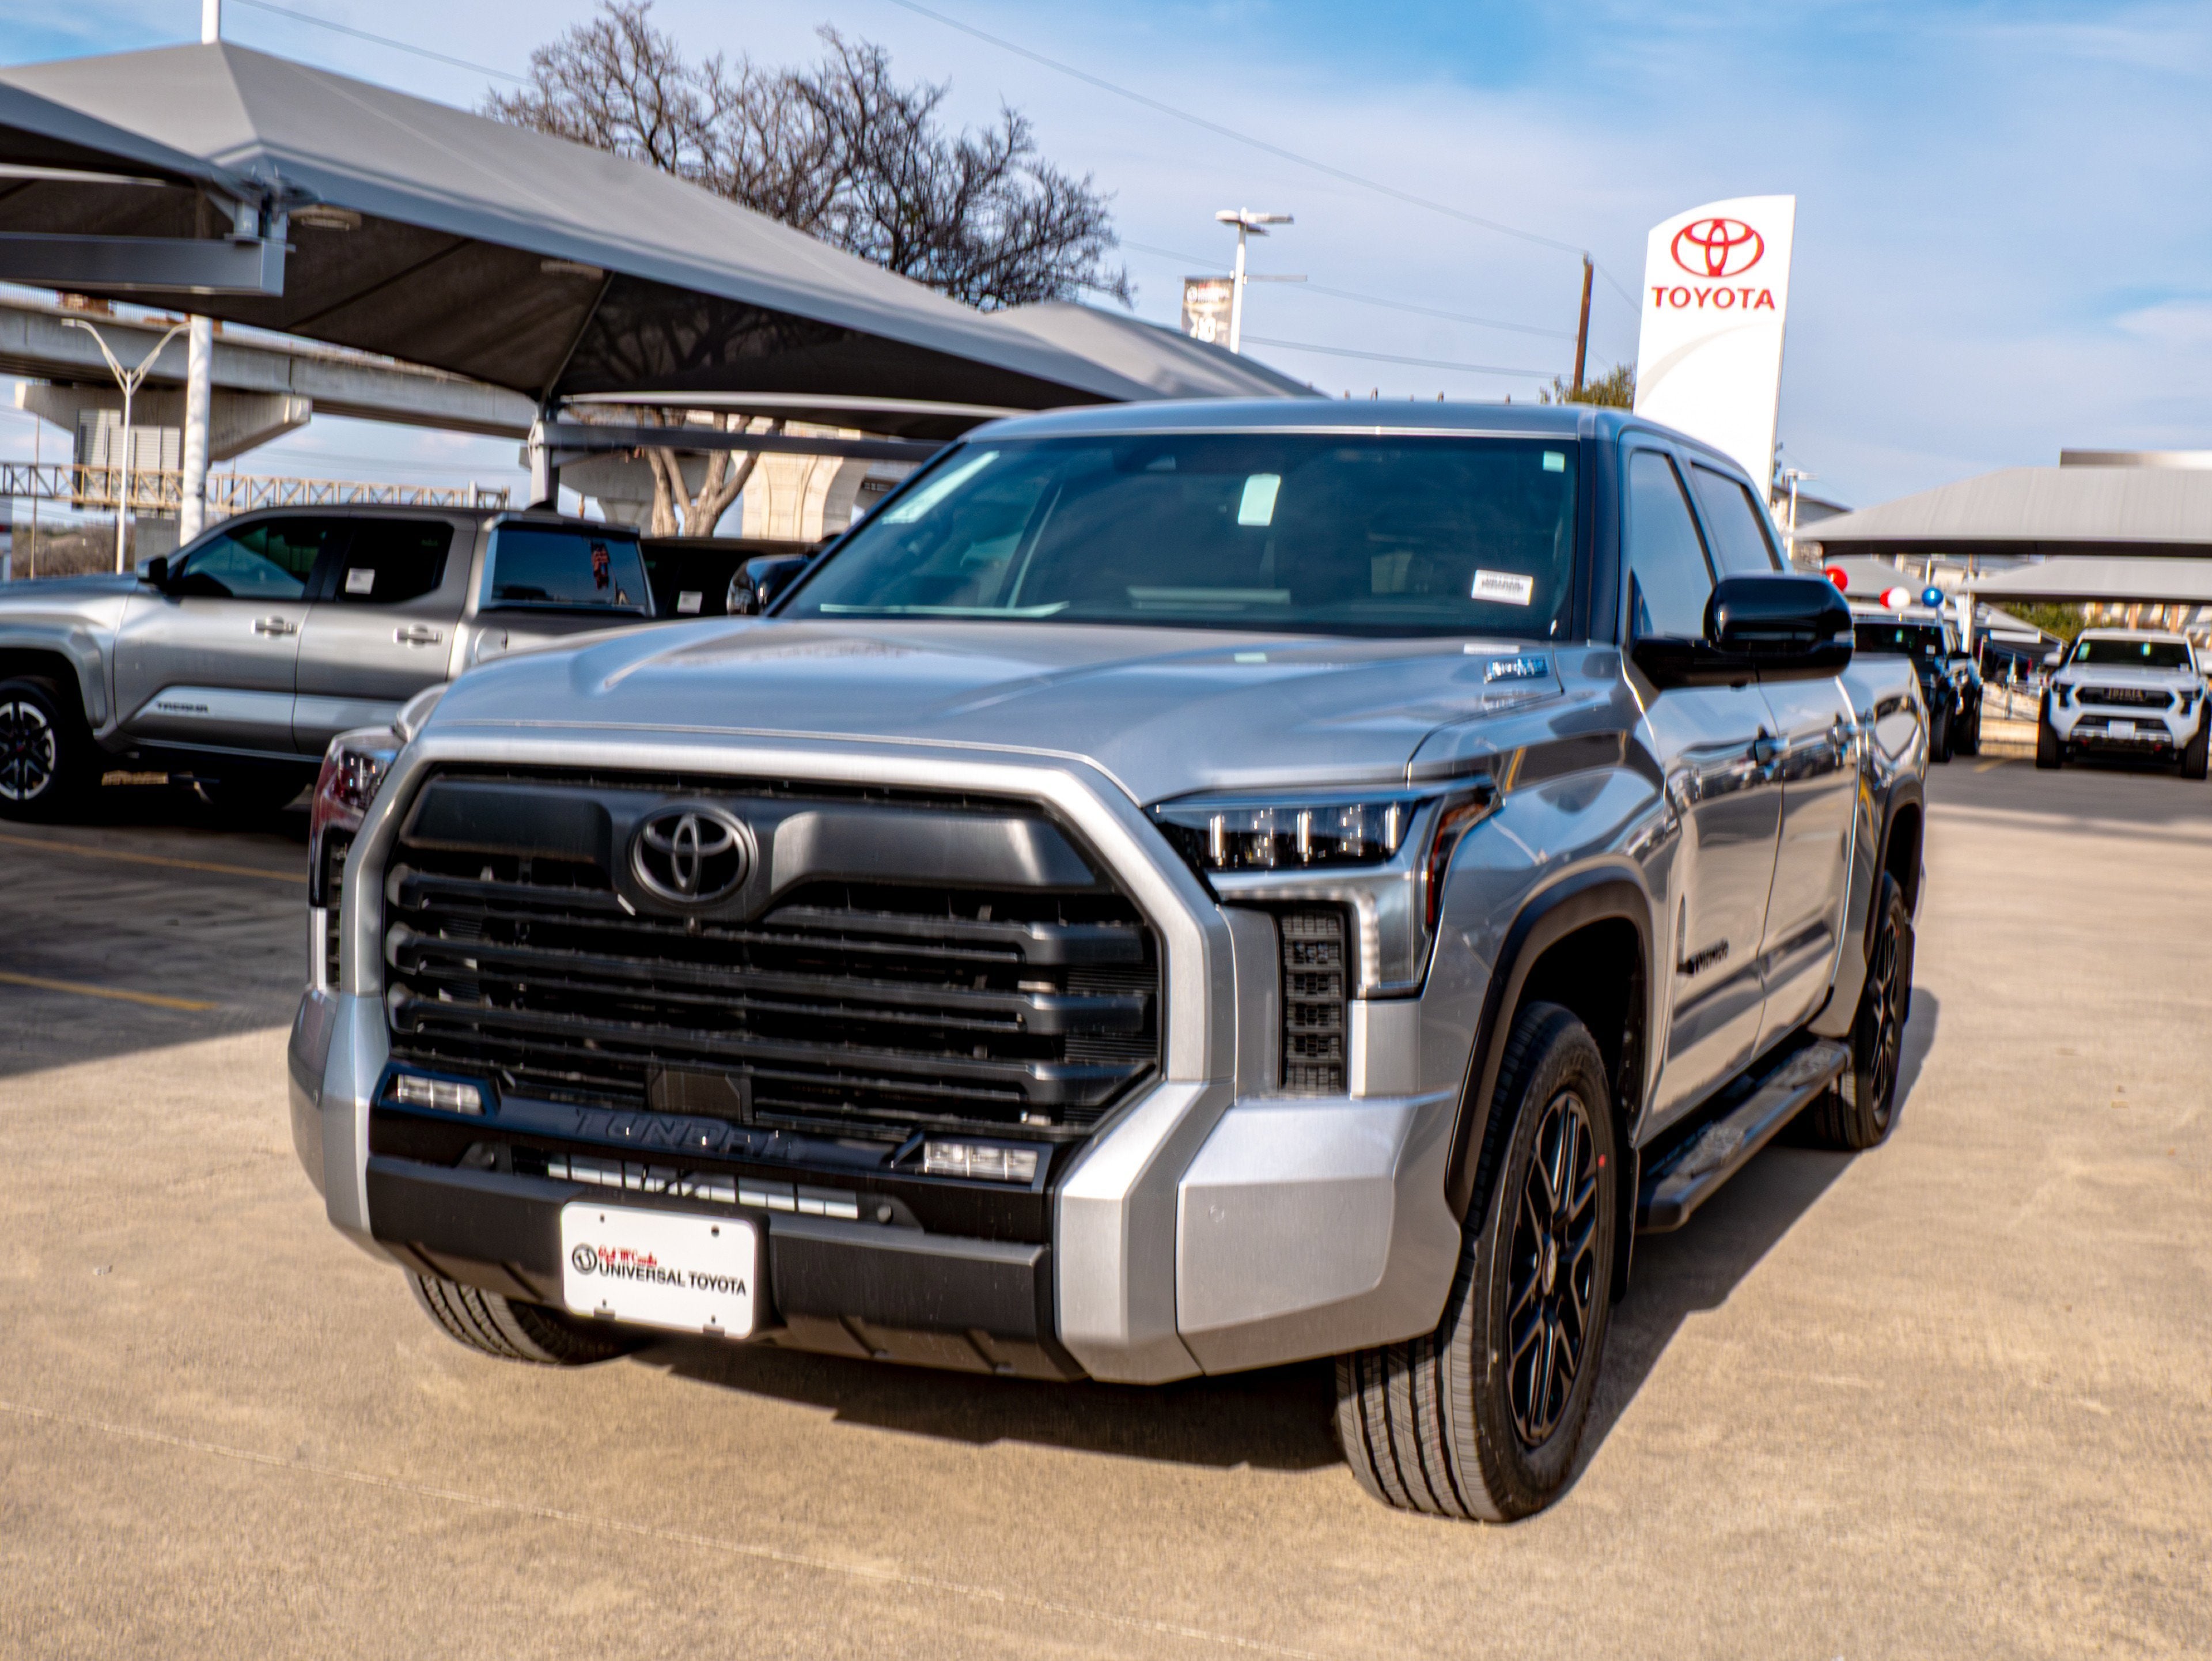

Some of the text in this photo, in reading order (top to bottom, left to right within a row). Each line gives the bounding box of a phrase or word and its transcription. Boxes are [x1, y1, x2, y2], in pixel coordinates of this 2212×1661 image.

[1651, 286, 1775, 311] TOYOTA
[599, 1262, 747, 1296] UNIVERSAL TOYOTA
